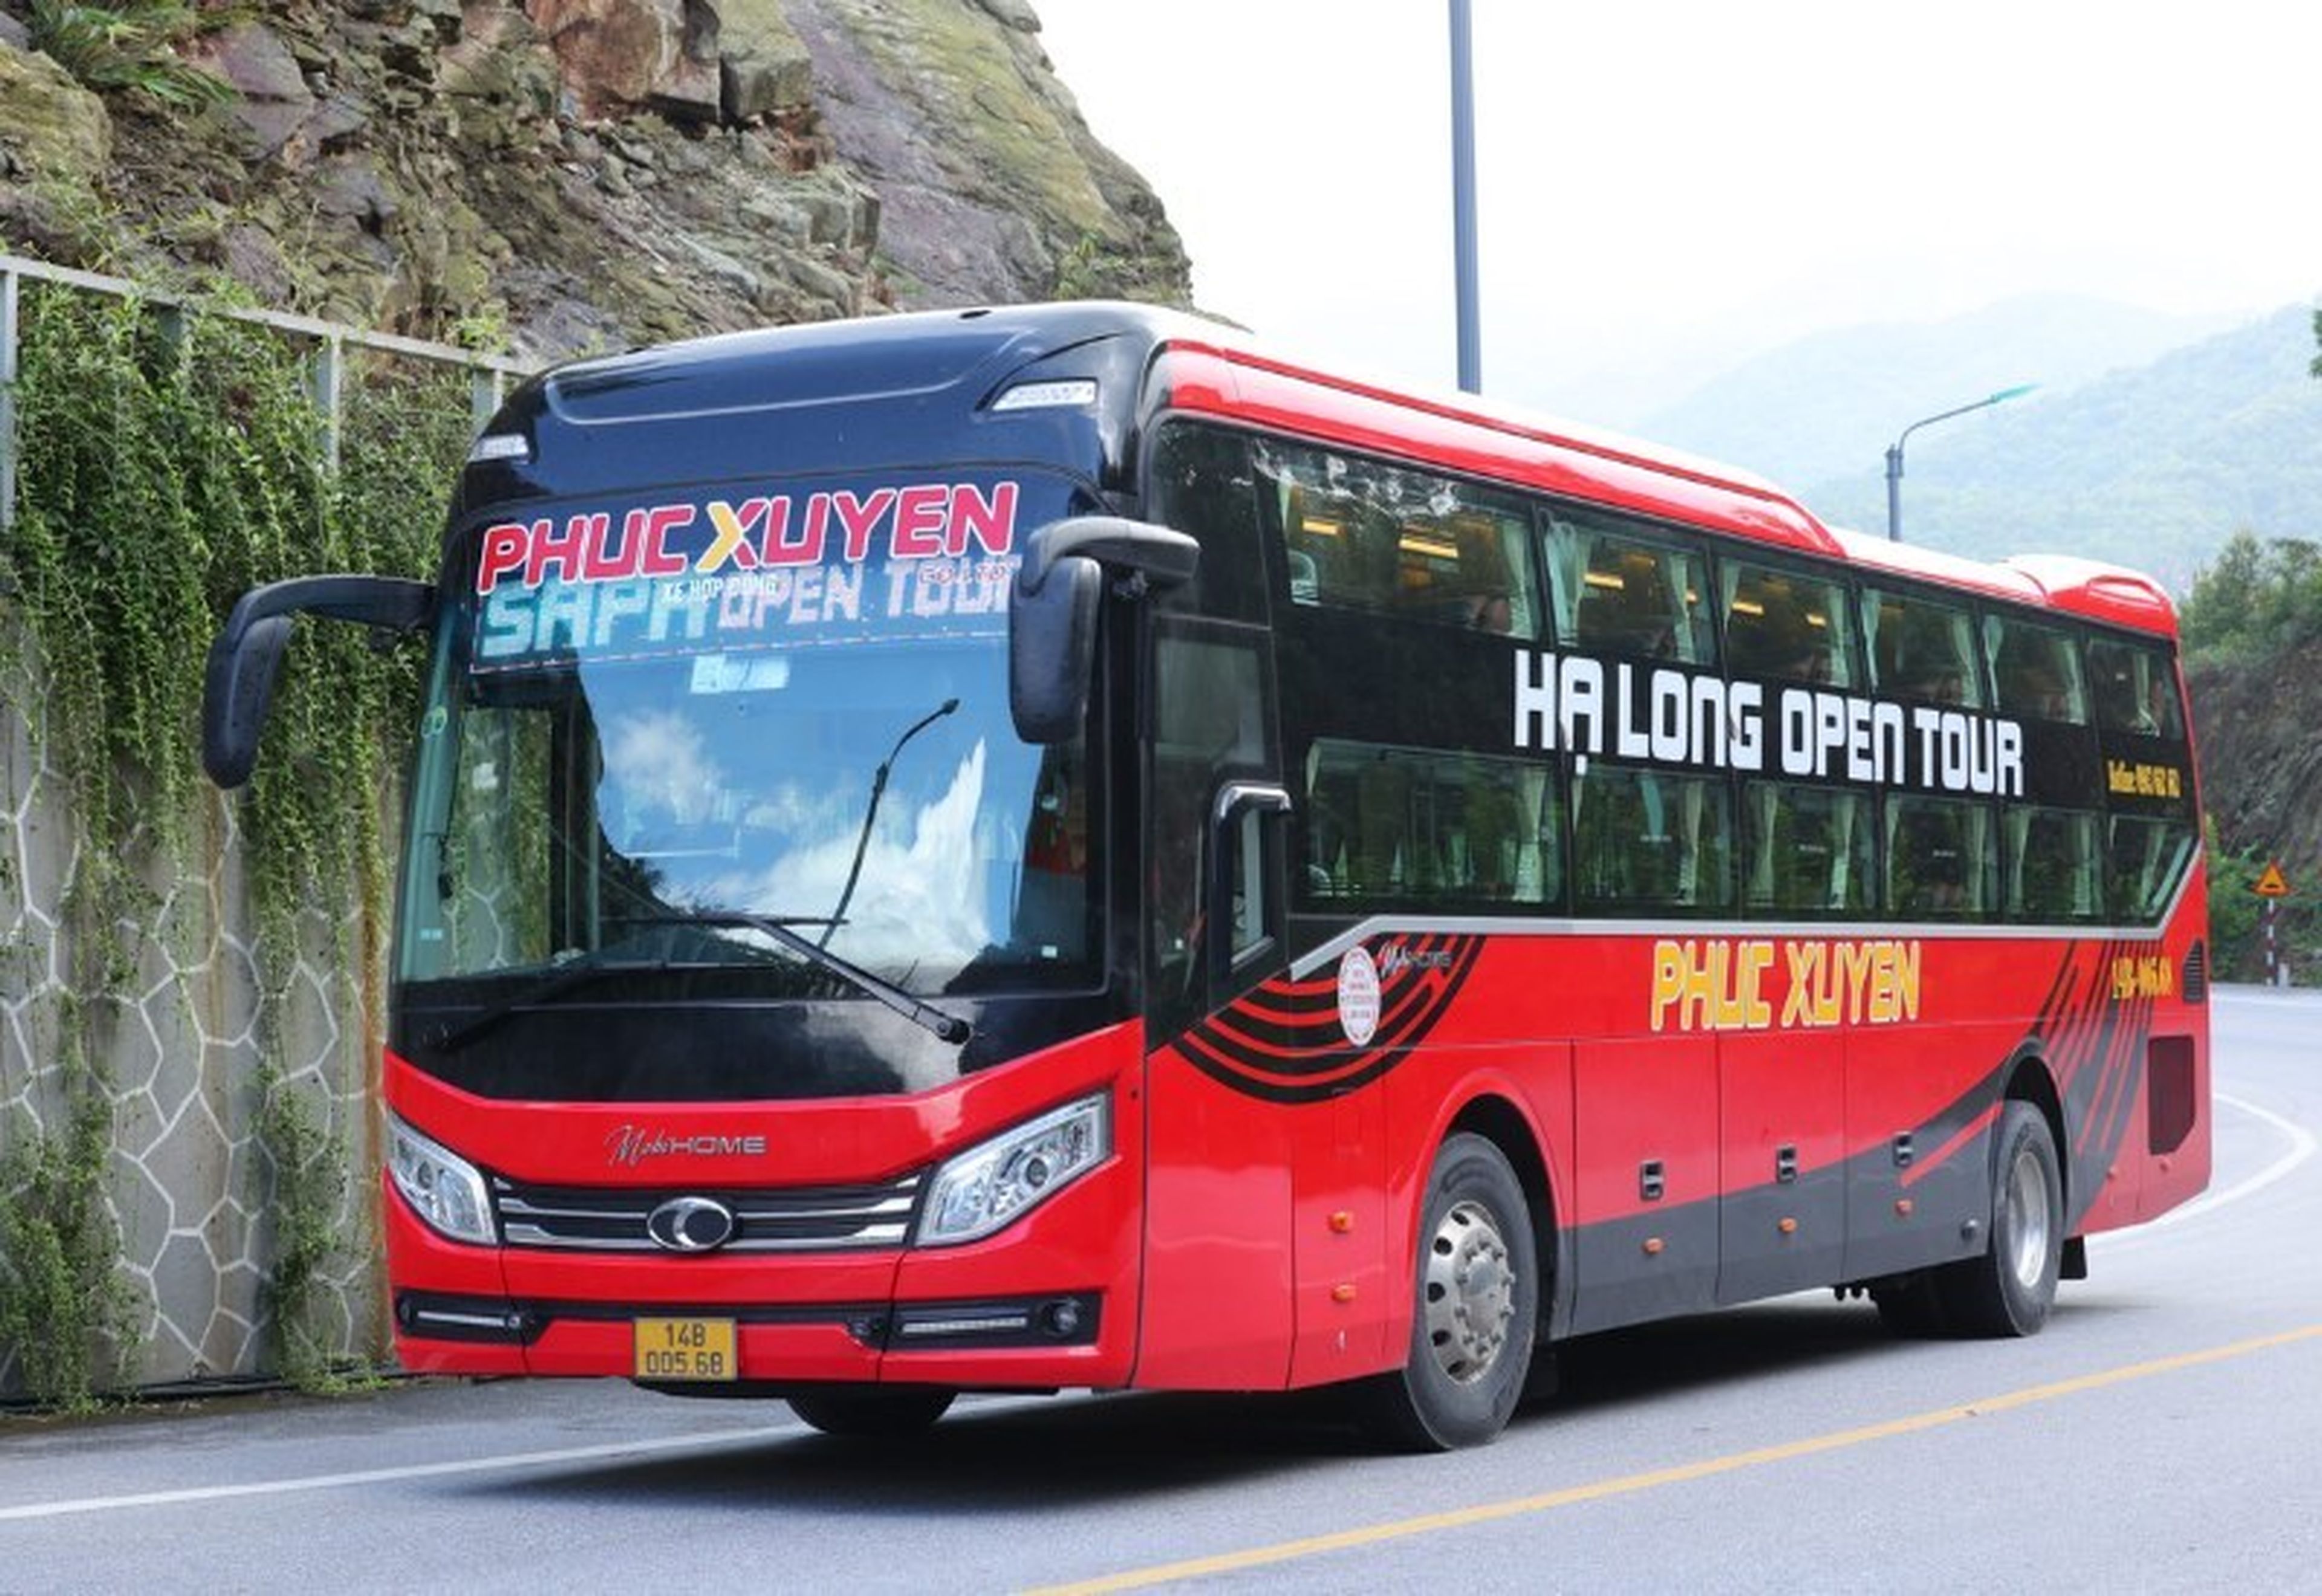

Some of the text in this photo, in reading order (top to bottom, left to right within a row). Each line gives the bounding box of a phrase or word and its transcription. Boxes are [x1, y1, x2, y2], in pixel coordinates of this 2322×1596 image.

[476, 481, 1018, 595] PHUC XUYEN
[482, 571, 706, 658] SAPA
[716, 557, 863, 630] OPEN
[1617, 662, 1763, 771] LONG
[1780, 689, 1905, 785] OPEN
[1914, 706, 2024, 797] TOUR
[1651, 940, 1921, 1031] PHUC XUYEN
[646, 1351, 724, 1375] 005.68
[666, 1322, 706, 1348] 14B
